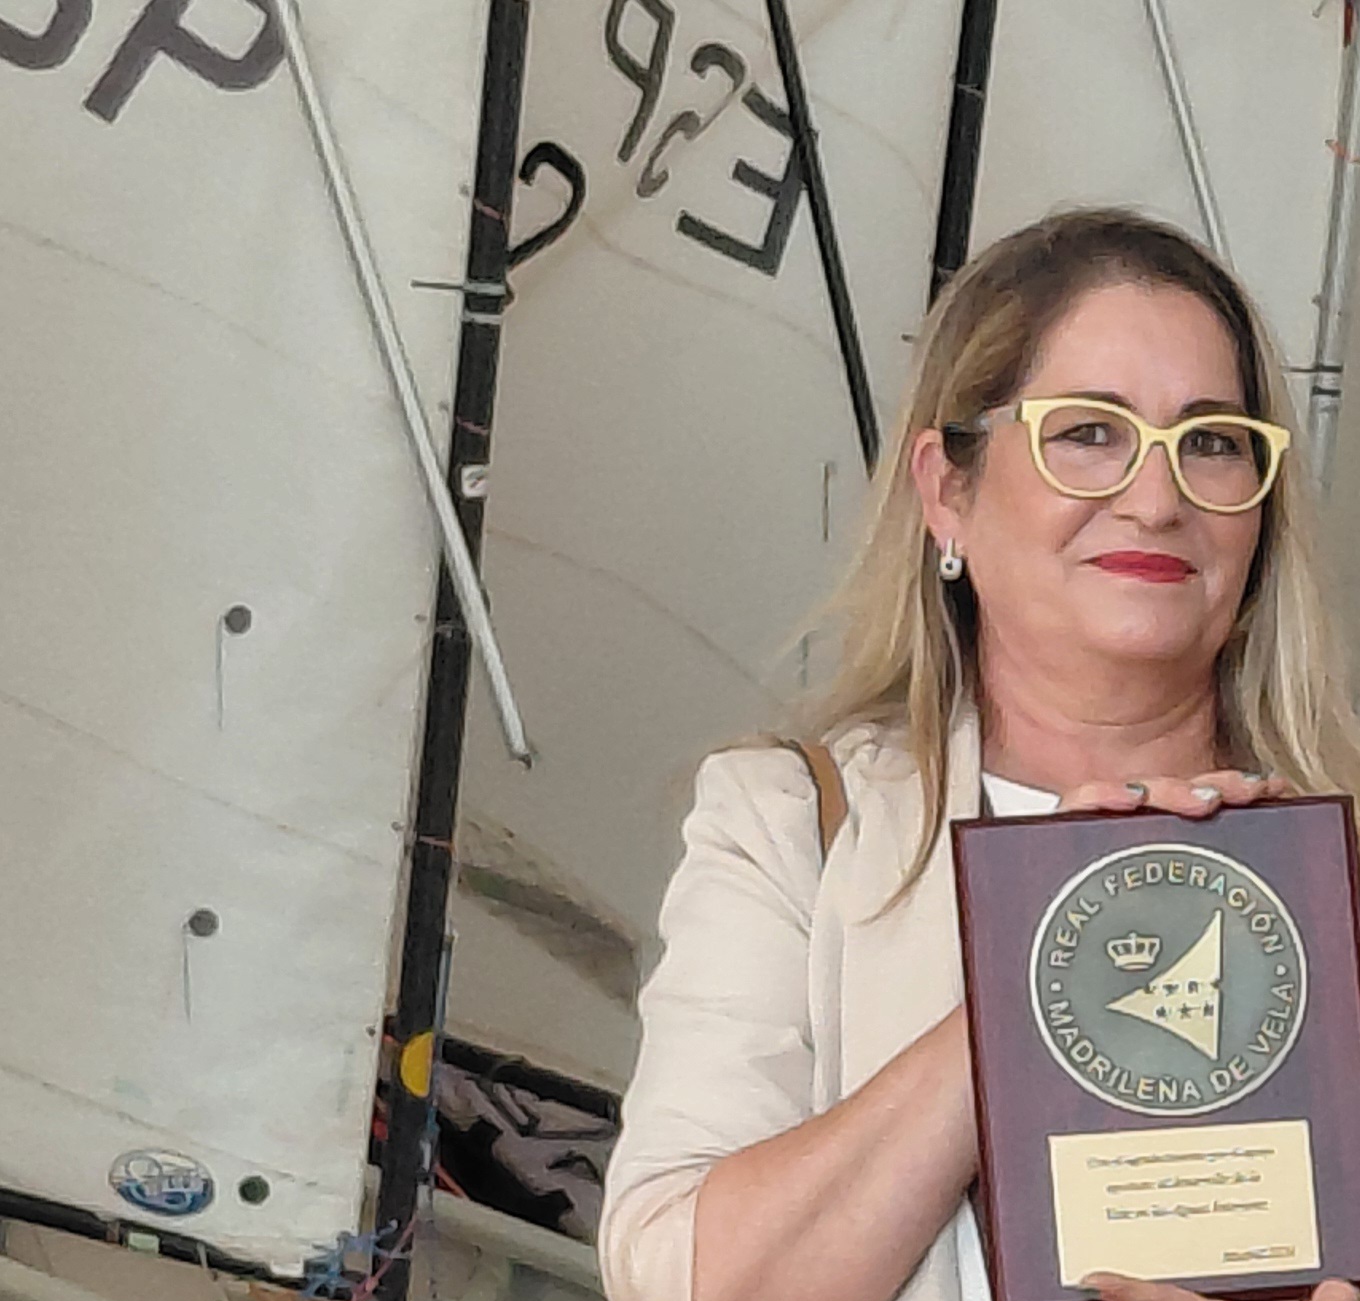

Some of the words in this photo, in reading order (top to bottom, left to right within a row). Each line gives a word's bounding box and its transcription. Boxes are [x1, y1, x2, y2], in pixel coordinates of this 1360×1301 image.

[1049, 896, 1102, 969] REAL
[1103, 859, 1286, 955] FEDERACIÓN
[1047, 1000, 1202, 1103] MADRILEÑA
[1208, 1055, 1253, 1094] DE
[1247, 982, 1295, 1055] VELA
